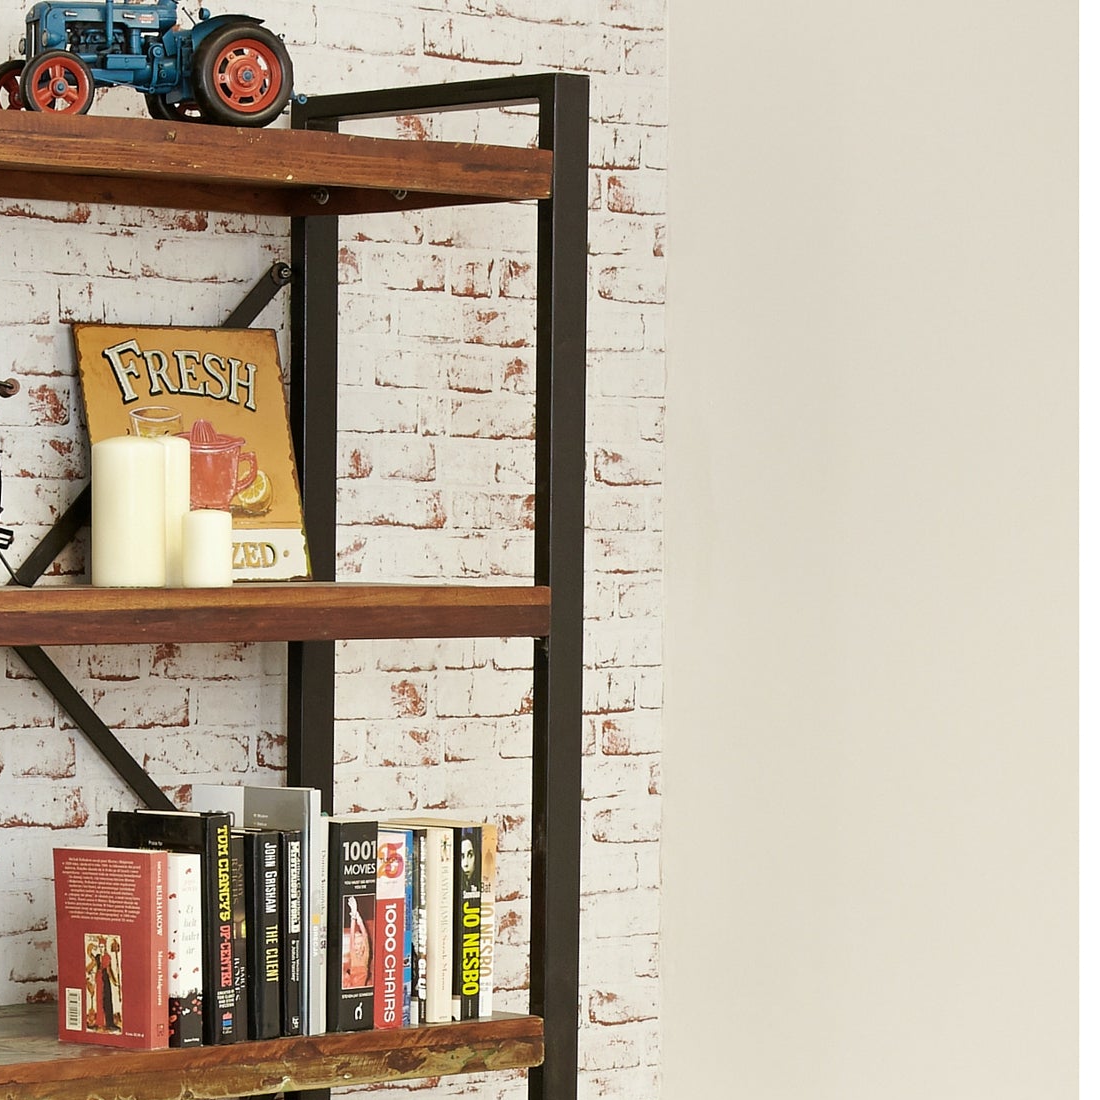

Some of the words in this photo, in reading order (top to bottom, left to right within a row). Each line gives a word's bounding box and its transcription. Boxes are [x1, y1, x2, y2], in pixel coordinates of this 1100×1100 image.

[103, 339, 257, 411] FRESH
[217, 825, 228, 857] TOM
[264, 842, 277, 868] JOHN
[343, 840, 376, 861] 1001
[218, 858, 232, 921] CLANCY'S
[344, 863, 375, 875] MOVIES
[264, 871, 278, 913] GRISHAM
[265, 924, 278, 944] THE
[384, 902, 397, 952] 1000
[463, 901, 480, 928] JO
[219, 924, 233, 987] OP-CENTRE
[265, 948, 279, 983] CLIENT
[462, 933, 480, 996] NESBO
[480, 924, 494, 977] NESBO
[384, 954, 397, 1022] CHAIRS
[418, 958, 427, 1000] CLUB
